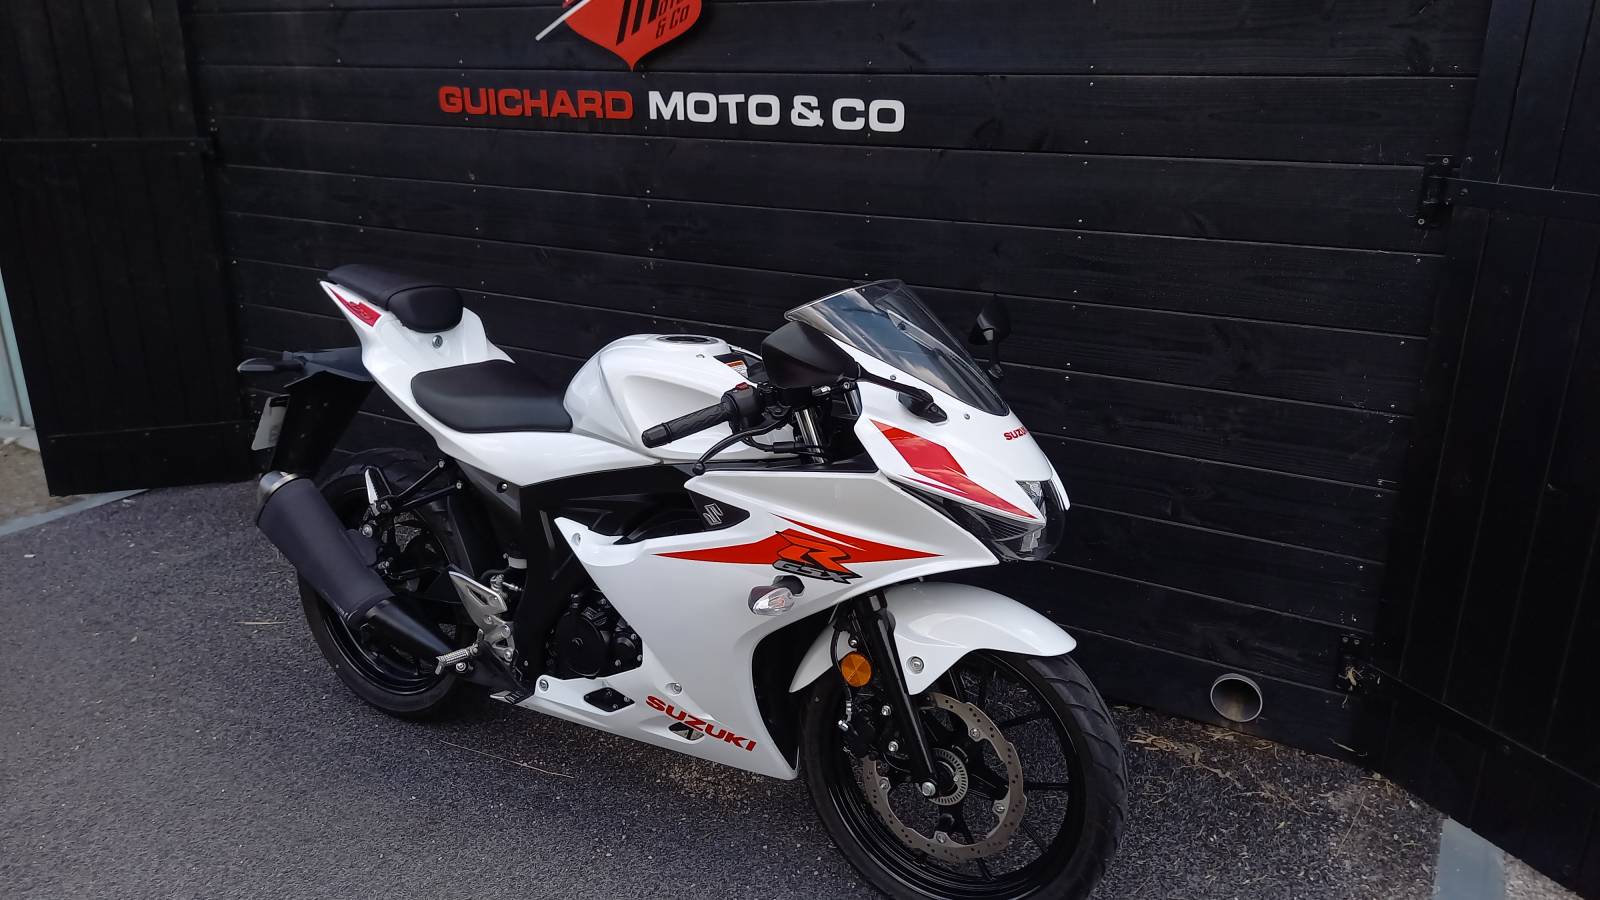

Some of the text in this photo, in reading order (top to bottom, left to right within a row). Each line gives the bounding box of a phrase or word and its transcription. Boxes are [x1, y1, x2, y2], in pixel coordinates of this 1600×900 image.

[438, 86, 905, 132] GUICHARD MOTO & CO
[773, 560, 851, 584] GSX
[645, 695, 757, 751] SUZUKI
